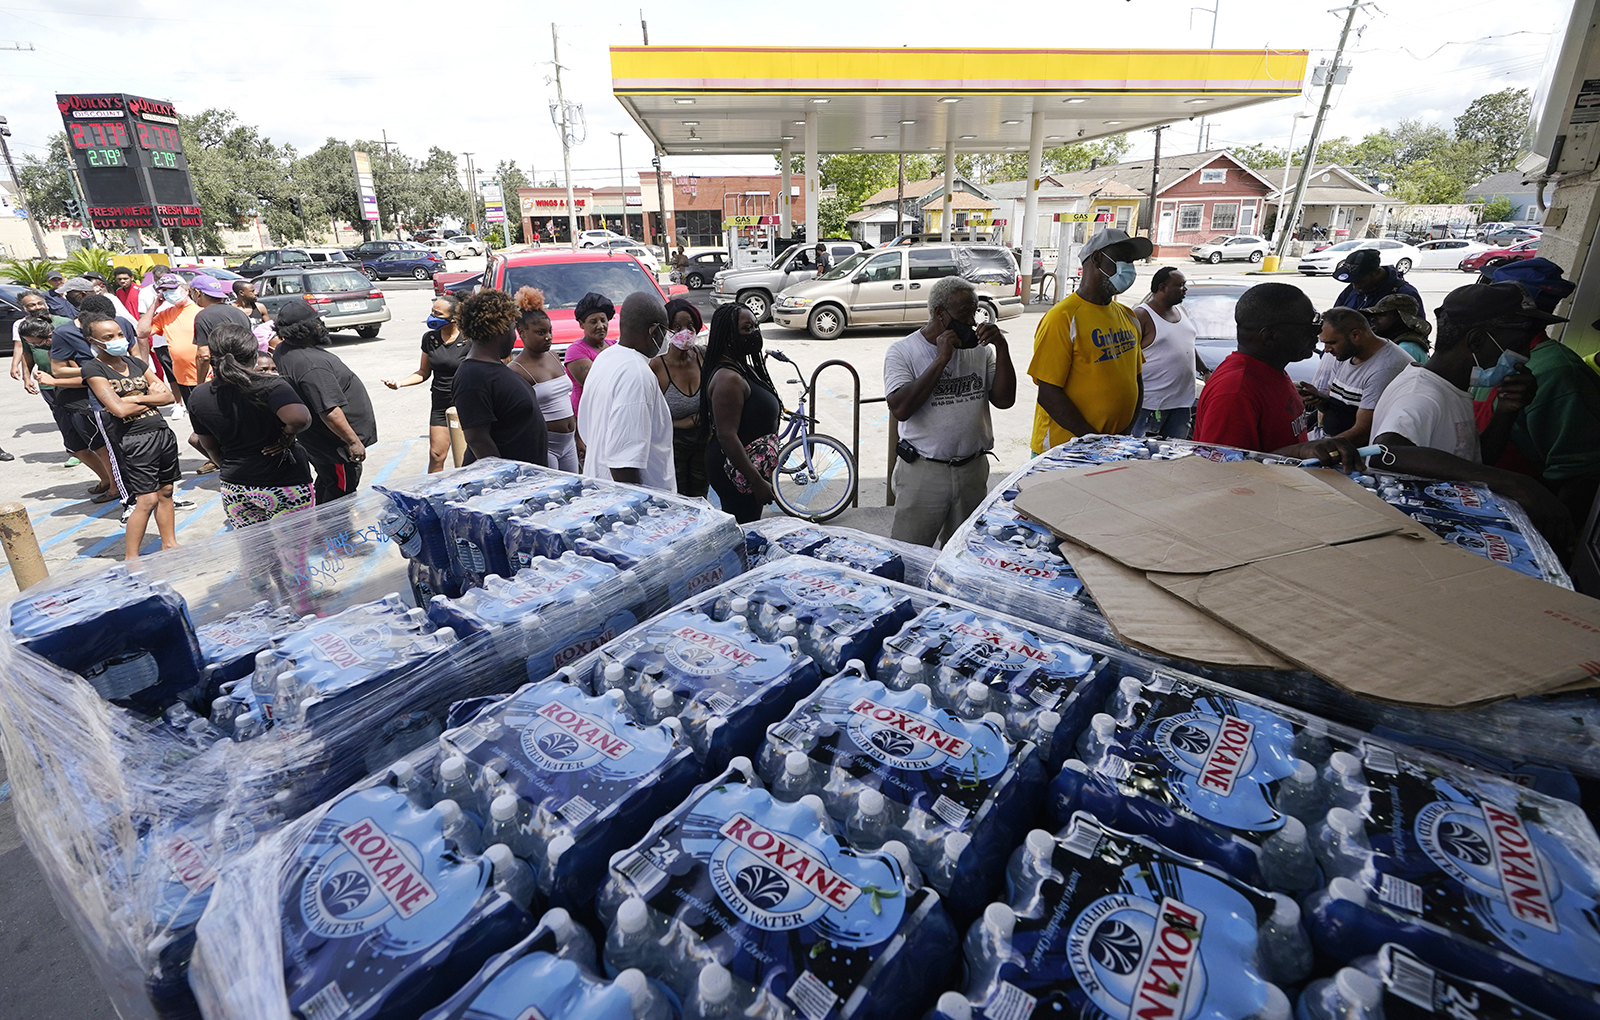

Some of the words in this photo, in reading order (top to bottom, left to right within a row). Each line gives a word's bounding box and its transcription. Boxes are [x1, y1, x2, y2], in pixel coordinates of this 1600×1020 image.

[87, 206, 122, 216] FRESH
[123, 206, 151, 216] MEAT
[93, 219, 115, 228] CUT
[122, 218, 151, 227] DAILY
[157, 205, 182, 215] FRESH
[183, 206, 200, 215] MEAT
[162, 217, 178, 226] CUT
[181, 217, 202, 226] DAILY
[768, 216, 774, 225] 9
[505, 572, 583, 605] ROXANE
[789, 572, 861, 600] ROXANE
[313, 633, 361, 668] ROXANE
[678, 627, 757, 667] ROXANE
[954, 623, 1053, 662] ROXANE
[540, 703, 628, 758] ROXANE
[848, 726, 886, 761] PURIFIED
[888, 759, 931, 769] WATER
[853, 700, 965, 757] ROXANE
[1156, 734, 1180, 763] WATER
[522, 728, 545, 763] PURIFIED
[543, 760, 584, 771] WATER
[1203, 717, 1250, 792] ROXANE
[1417, 802, 1455, 837] PURIFIED
[343, 822, 431, 913] ROXANE
[650, 839, 680, 865] 24
[725, 818, 854, 907] ROXANE
[1419, 837, 1469, 884] WATER
[1485, 806, 1552, 925] ROXANE
[303, 864, 327, 921] PURIFIED
[315, 919, 365, 935] WATER
[711, 858, 747, 915] PURIFIED
[749, 912, 805, 928] WATER
[1075, 896, 1131, 937] PURIFIED
[1071, 936, 1100, 994] WATER
